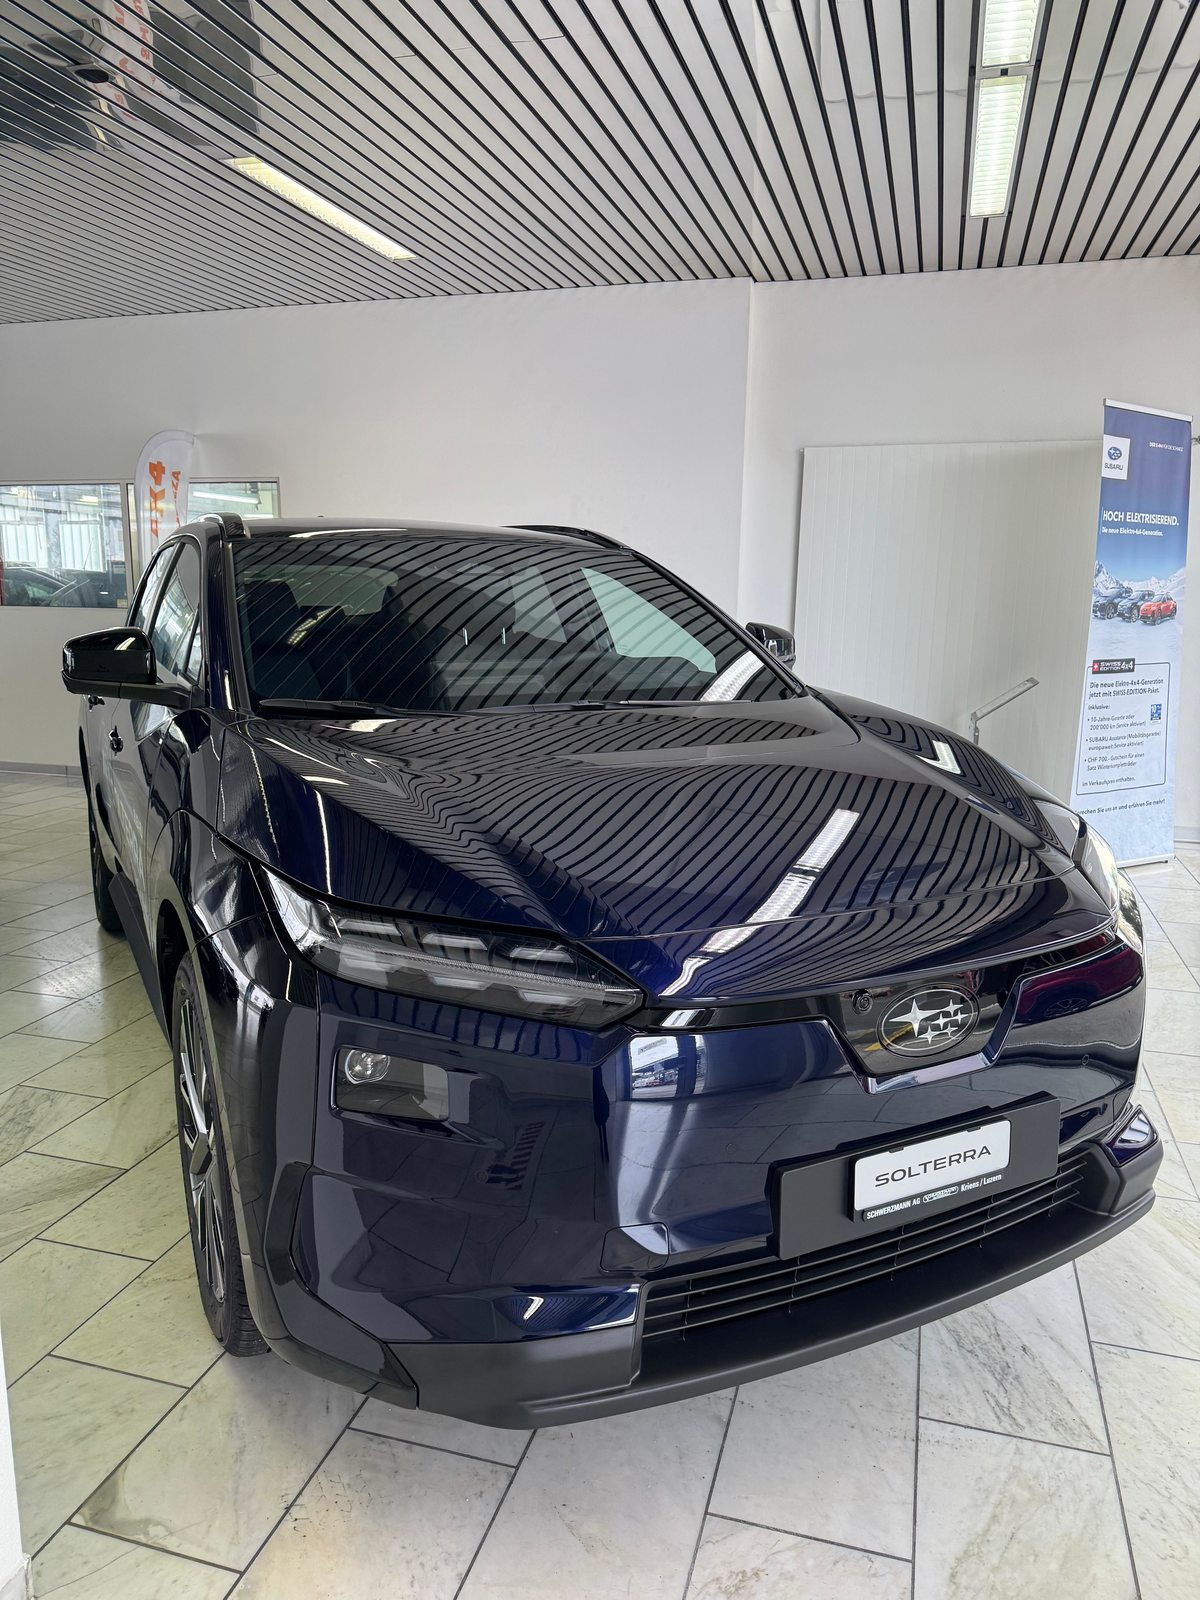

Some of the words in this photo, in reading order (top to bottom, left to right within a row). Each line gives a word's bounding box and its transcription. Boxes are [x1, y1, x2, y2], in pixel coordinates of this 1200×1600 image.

[1103, 511, 1124, 522] HOCH
[1126, 512, 1179, 526] ELEKTRISIEREND.
[1121, 661, 1133, 670] 4x4
[1115, 679, 1163, 687] Elektro-4x4-Generation
[1089, 691, 1101, 699] jetzt
[875, 1146, 991, 1187] SOLTERRA
[866, 1202, 911, 1219] SCHWERZMANN
[912, 1197, 921, 1208] AG
[961, 1181, 979, 1191] Kriens
[983, 1174, 1002, 1184] Luzern
